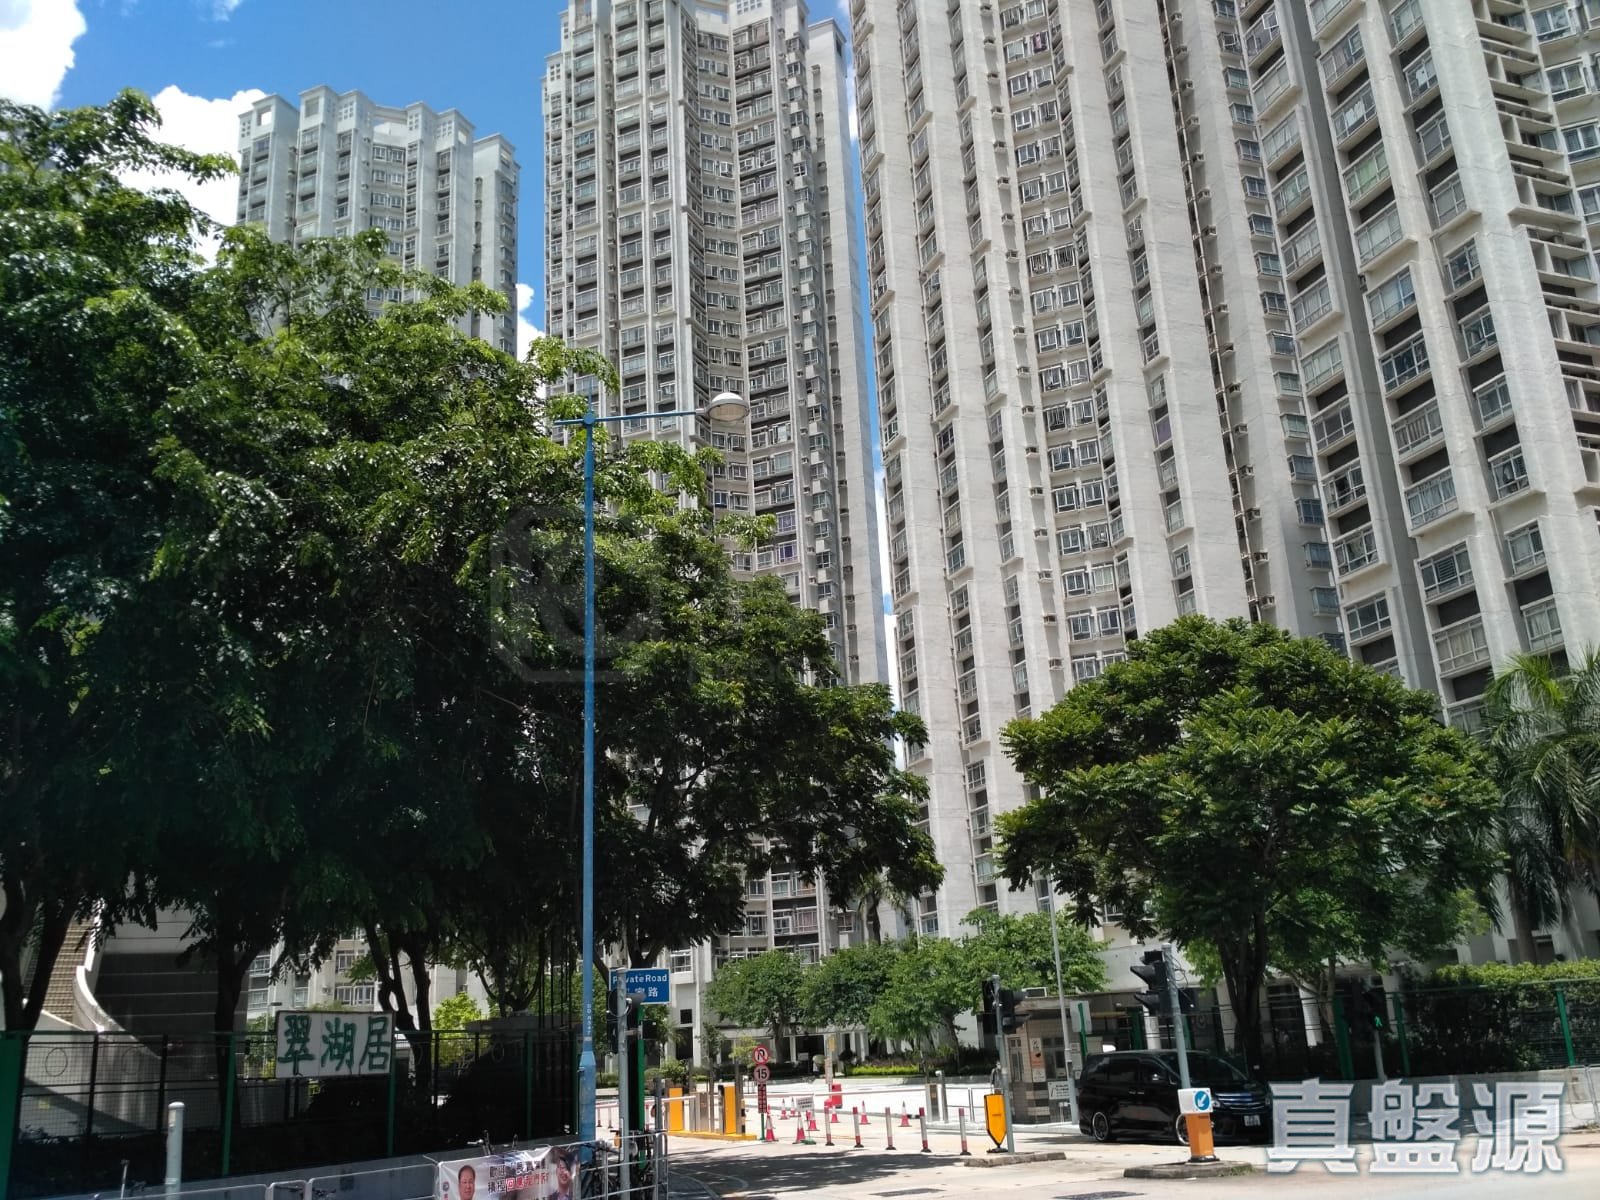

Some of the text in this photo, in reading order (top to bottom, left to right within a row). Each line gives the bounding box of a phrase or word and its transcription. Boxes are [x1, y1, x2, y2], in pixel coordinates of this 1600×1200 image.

[612, 974, 668, 984] Pvate Road
[277, 1014, 391, 1075] 翠湖居
[756, 1068, 767, 1079] 15
